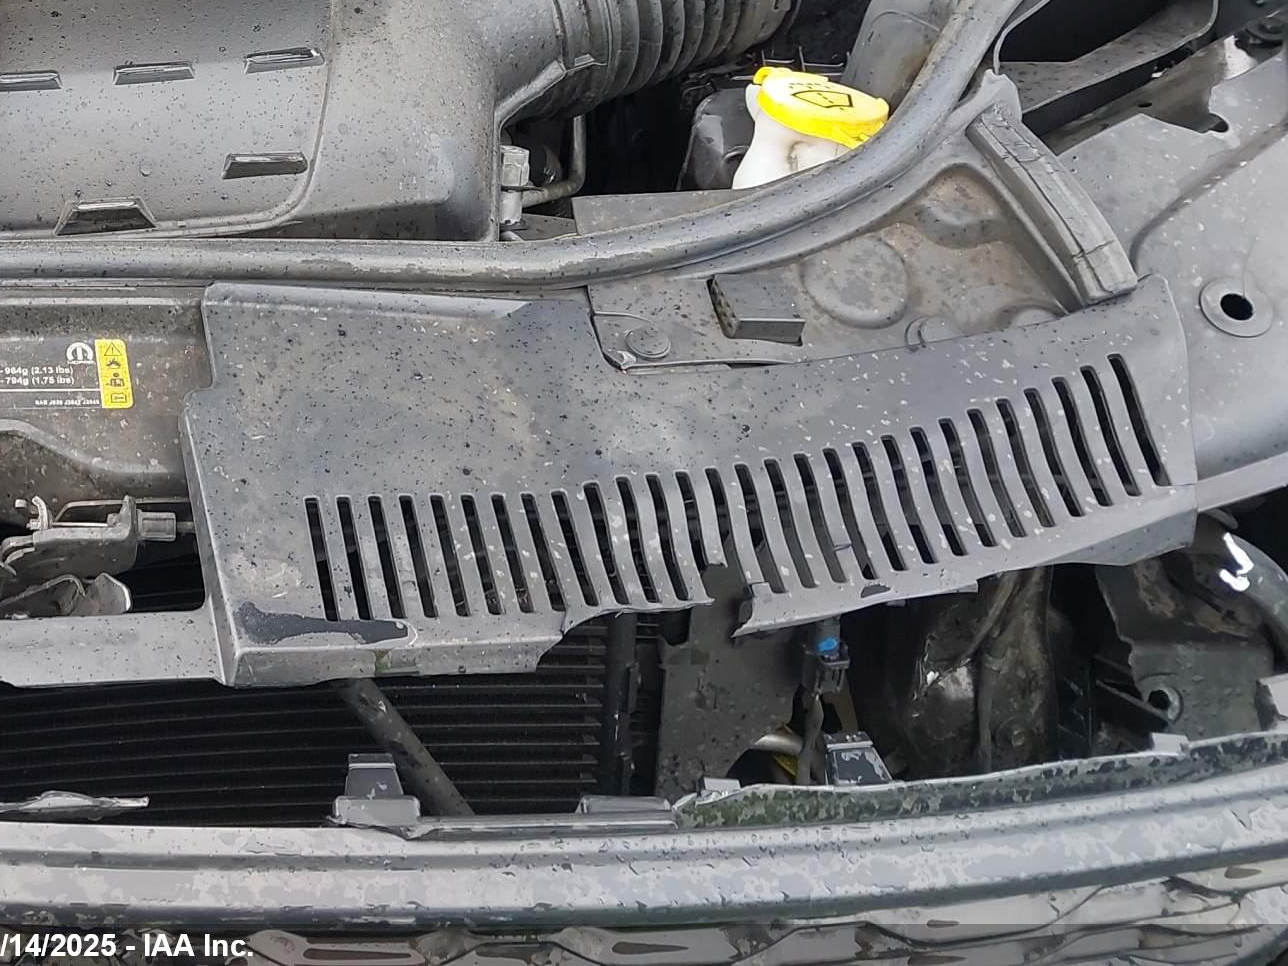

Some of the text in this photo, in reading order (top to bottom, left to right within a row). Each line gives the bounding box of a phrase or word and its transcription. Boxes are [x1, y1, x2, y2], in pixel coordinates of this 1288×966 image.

[31, 365, 54, 376] (2.13
[55, 364, 74, 376] lbs)
[31, 376, 55, 386] (1.75
[56, 374, 75, 386] lbs)
